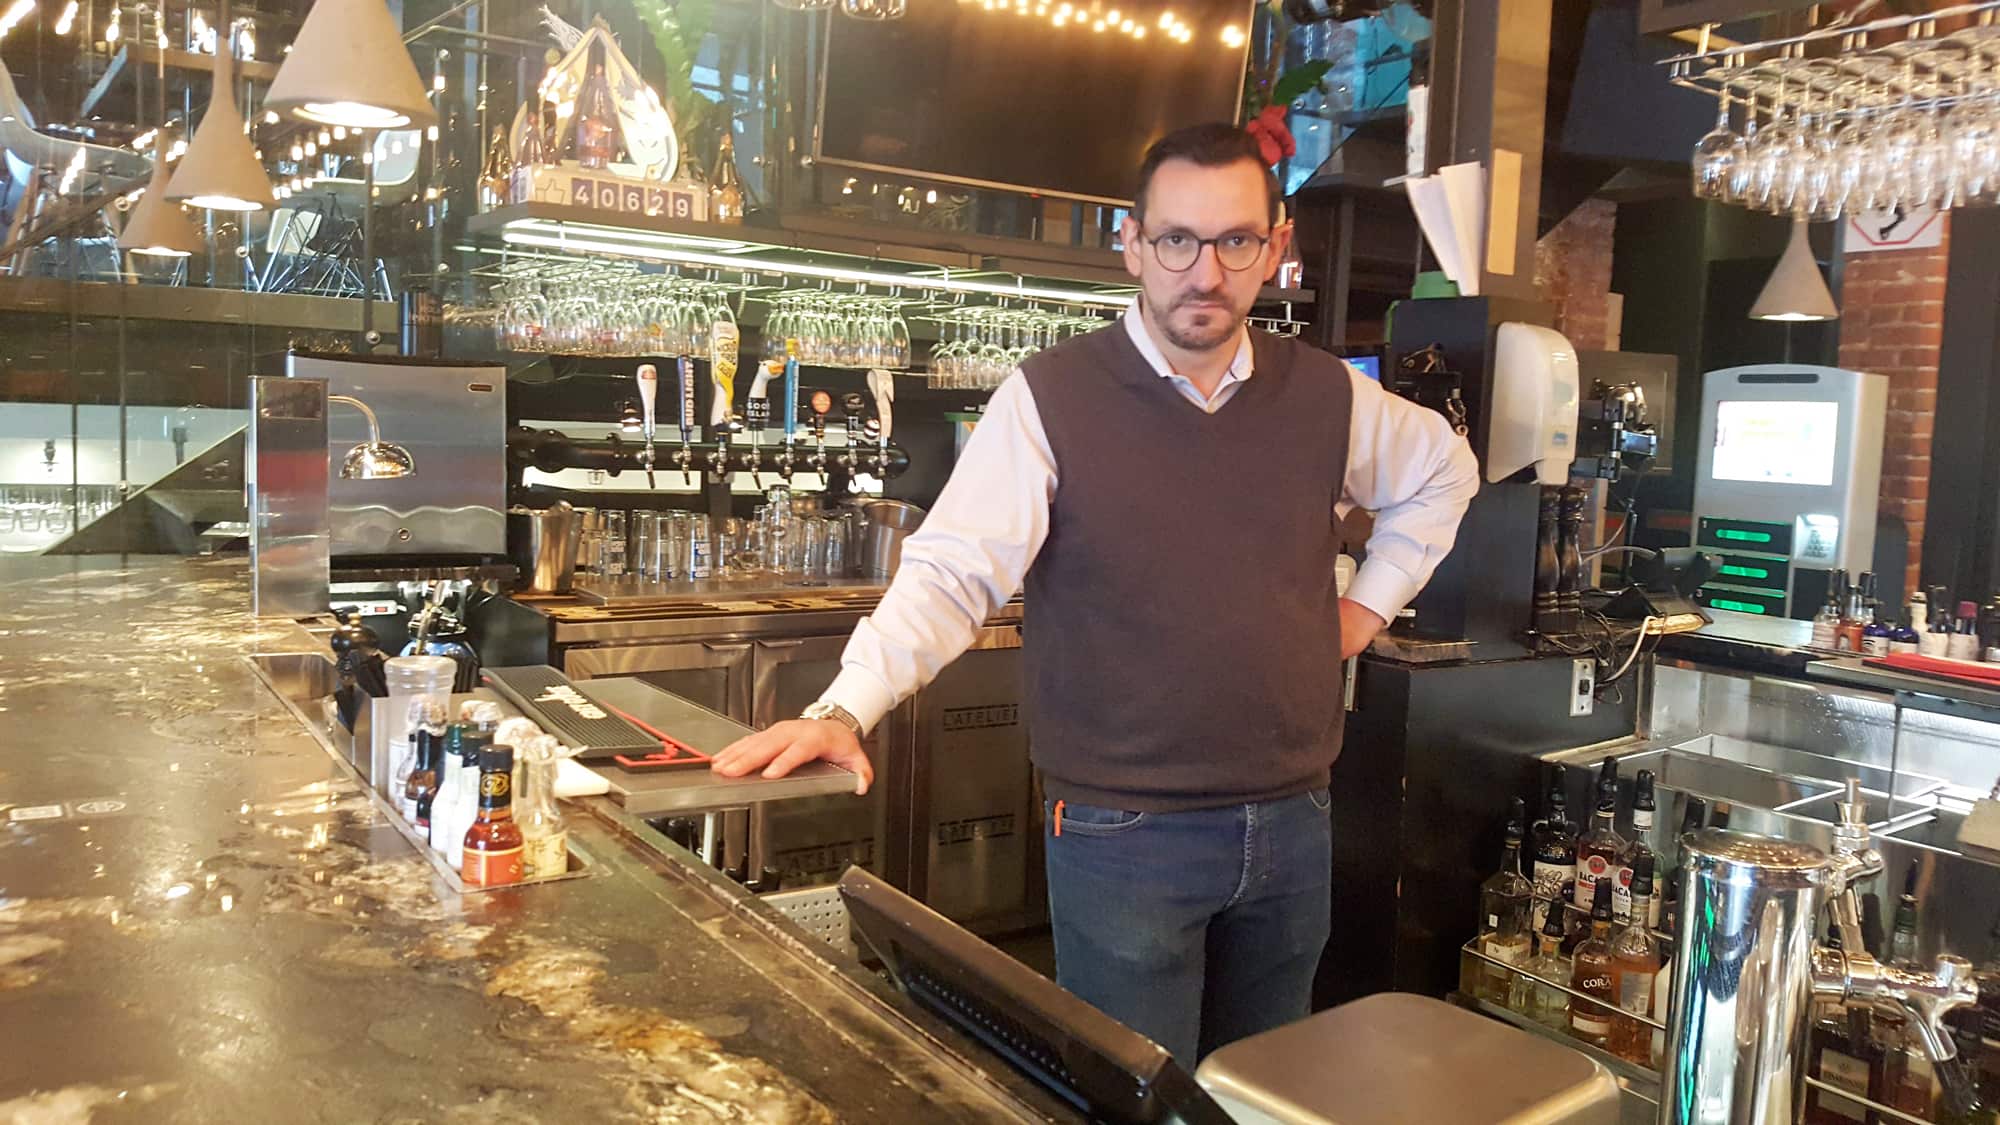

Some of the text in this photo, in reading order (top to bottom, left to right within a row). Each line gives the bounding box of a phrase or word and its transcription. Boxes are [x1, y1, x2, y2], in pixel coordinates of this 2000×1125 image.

[574, 184, 689, 218] 40629
[685, 360, 694, 426] BUD LIGHT
